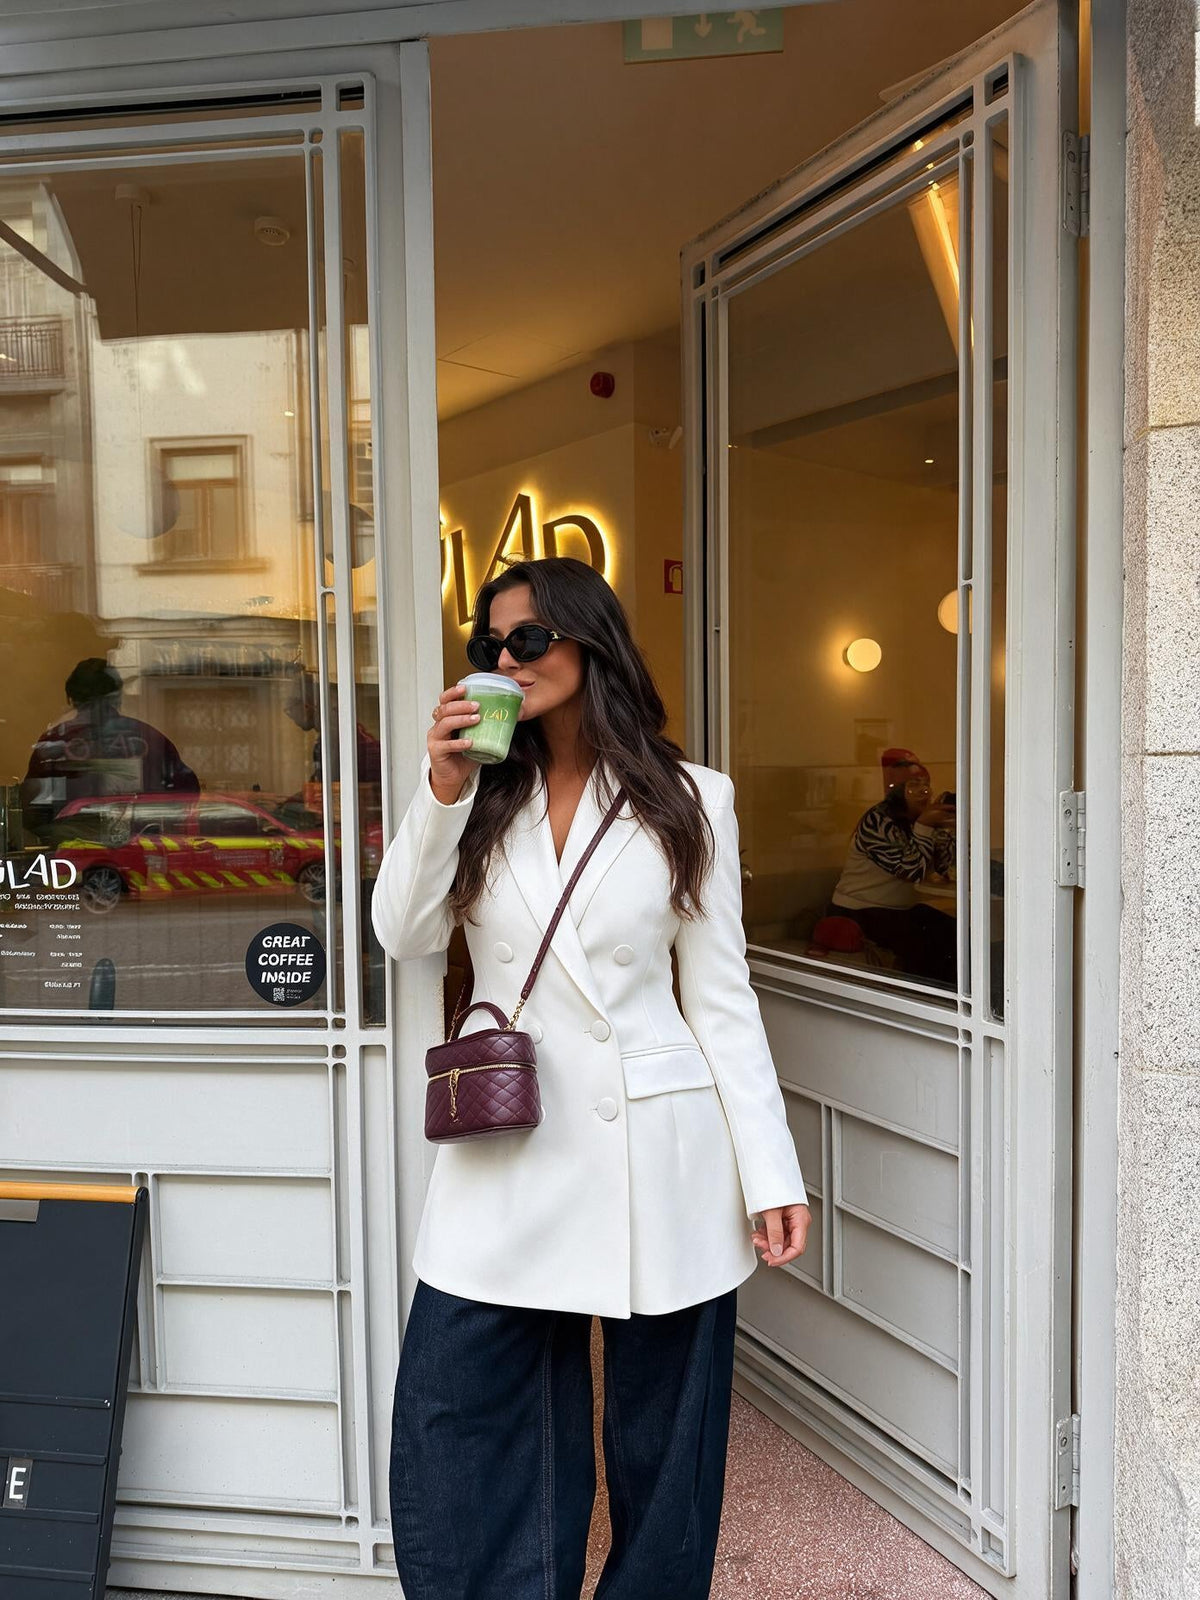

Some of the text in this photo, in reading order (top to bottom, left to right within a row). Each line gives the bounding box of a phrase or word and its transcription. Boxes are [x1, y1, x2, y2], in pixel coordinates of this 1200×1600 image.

[440, 493, 606, 627] LAD
[0, 853, 77, 890] LAD
[262, 935, 311, 948] GREAT
[258, 953, 314, 966] COFFEE
[260, 971, 312, 984] INSIDE
[9, 1467, 27, 1500] E
